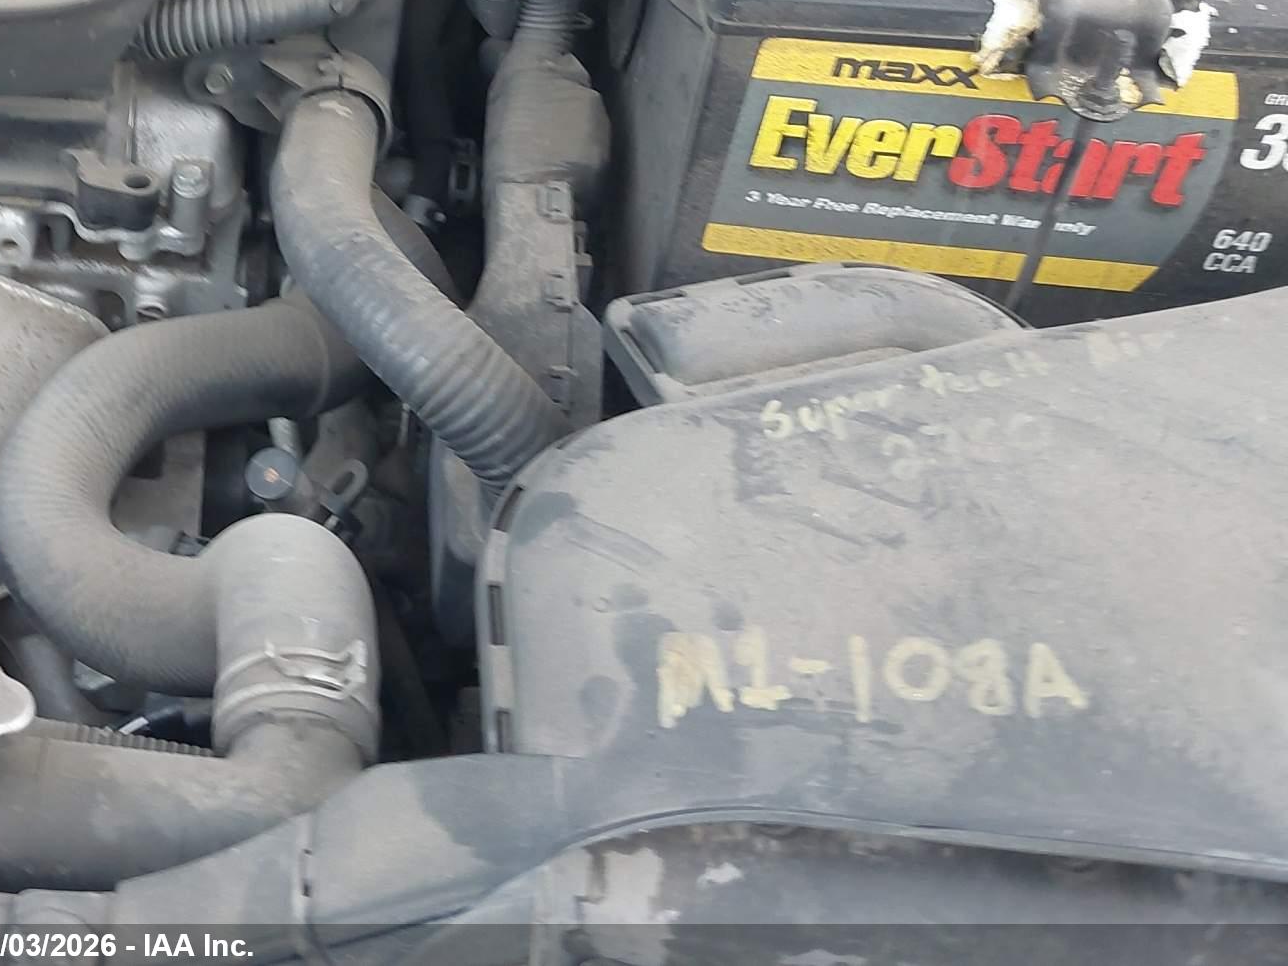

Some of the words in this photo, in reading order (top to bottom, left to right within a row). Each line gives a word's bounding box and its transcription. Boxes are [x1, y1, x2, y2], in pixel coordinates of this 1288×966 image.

[832, 56, 980, 90] maxx
[749, 94, 1208, 207] EverStart
[1239, 113, 1288, 172] 3
[765, 192, 813, 208] Year
[812, 197, 861, 212] Free
[861, 202, 999, 225] Replacement
[1212, 229, 1273, 252] 640
[1202, 252, 1258, 273] CCA
